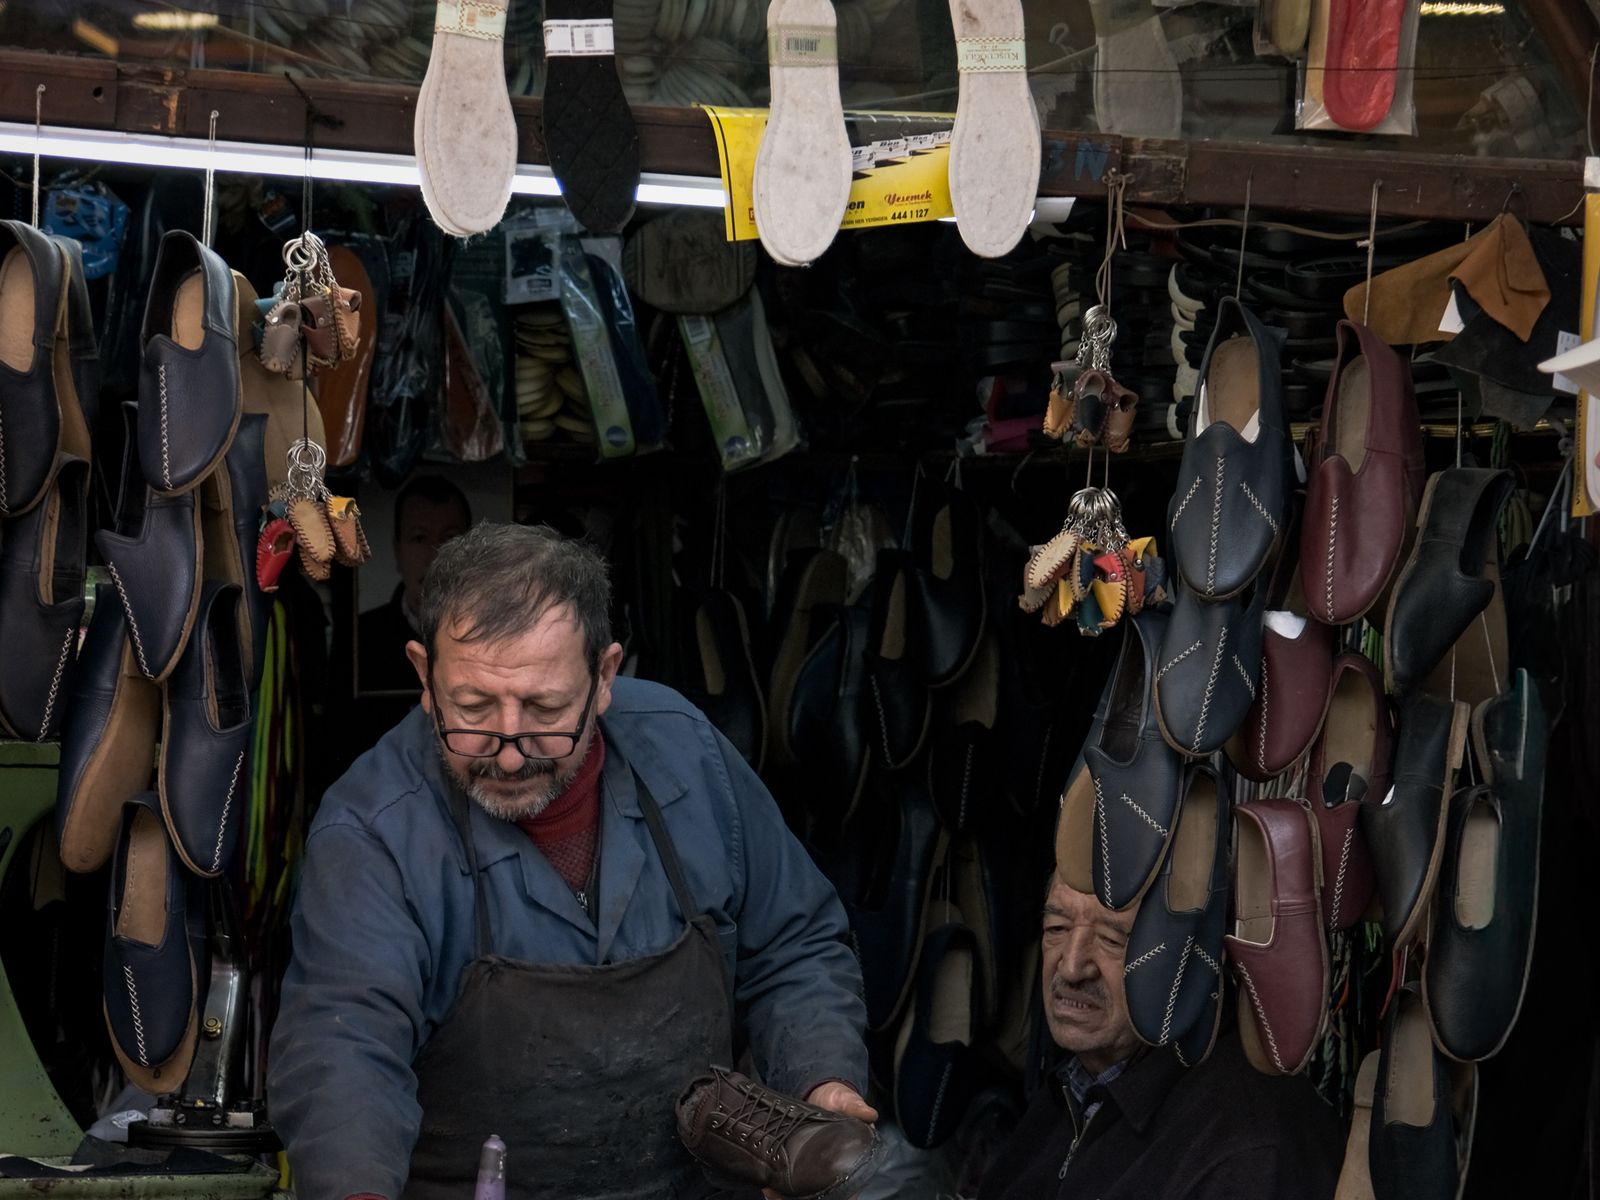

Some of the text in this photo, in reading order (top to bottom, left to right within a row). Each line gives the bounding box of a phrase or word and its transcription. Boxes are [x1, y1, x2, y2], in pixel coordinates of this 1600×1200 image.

[884, 190, 933, 205] Yesemek
[891, 211, 908, 220] 444
[915, 208, 929, 218] 127
